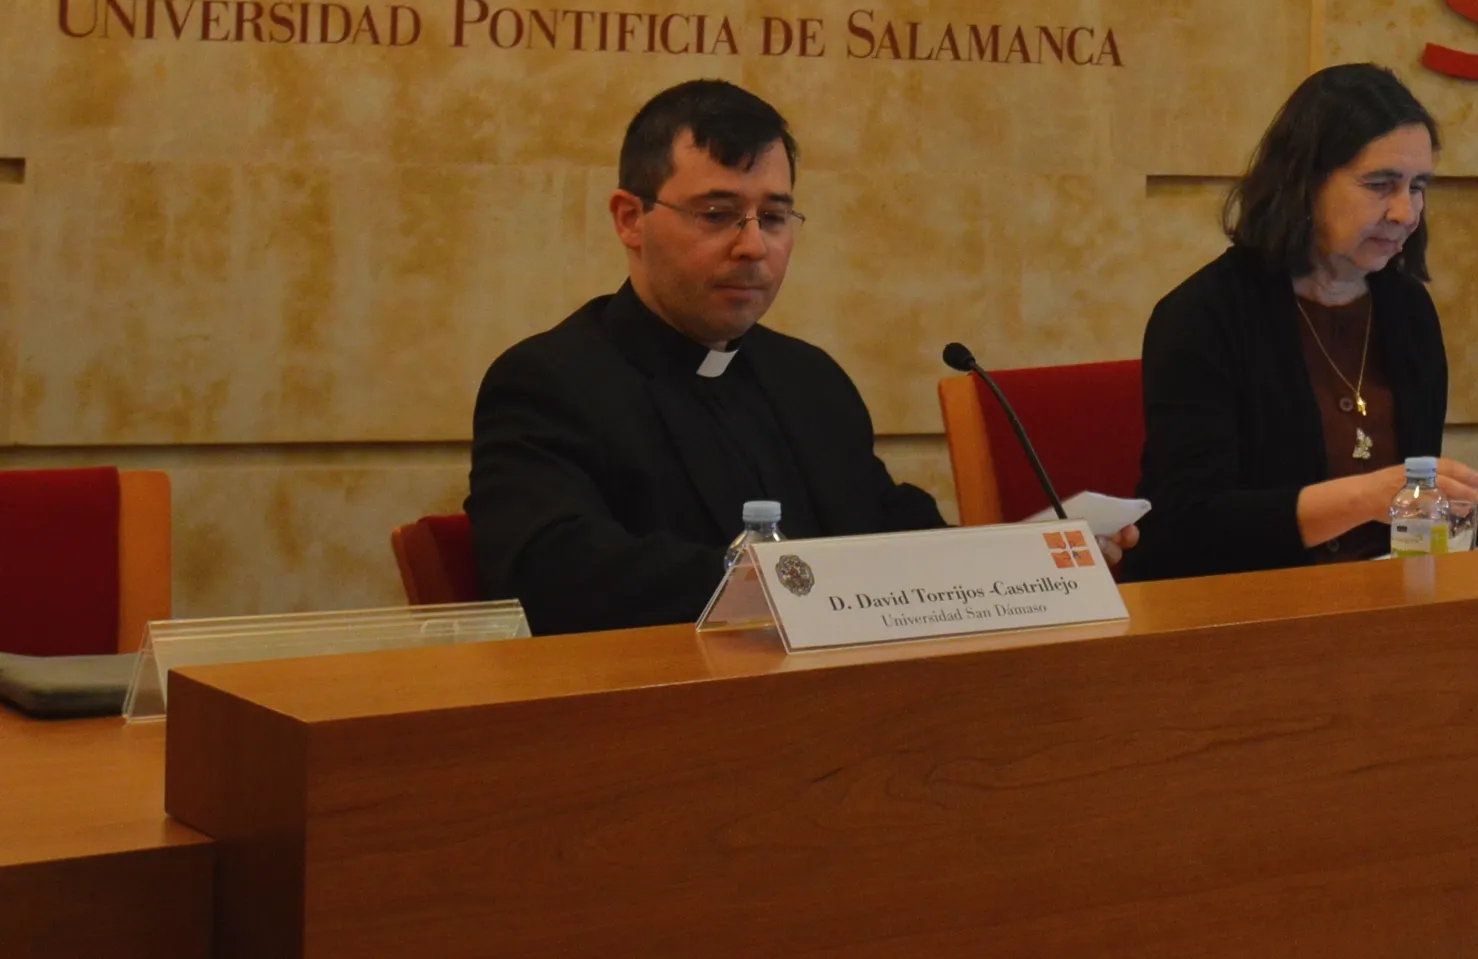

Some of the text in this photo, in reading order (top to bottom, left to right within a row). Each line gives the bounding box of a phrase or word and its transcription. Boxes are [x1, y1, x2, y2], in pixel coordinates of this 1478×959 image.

[760, 15, 825, 58] DE
[846, 8, 1125, 68] SALAMANCA
[828, 595, 853, 612] D.
[855, 589, 910, 610] David
[910, 584, 986, 605] Torrijos
[880, 602, 1047, 628] Universidad San Dámaso
